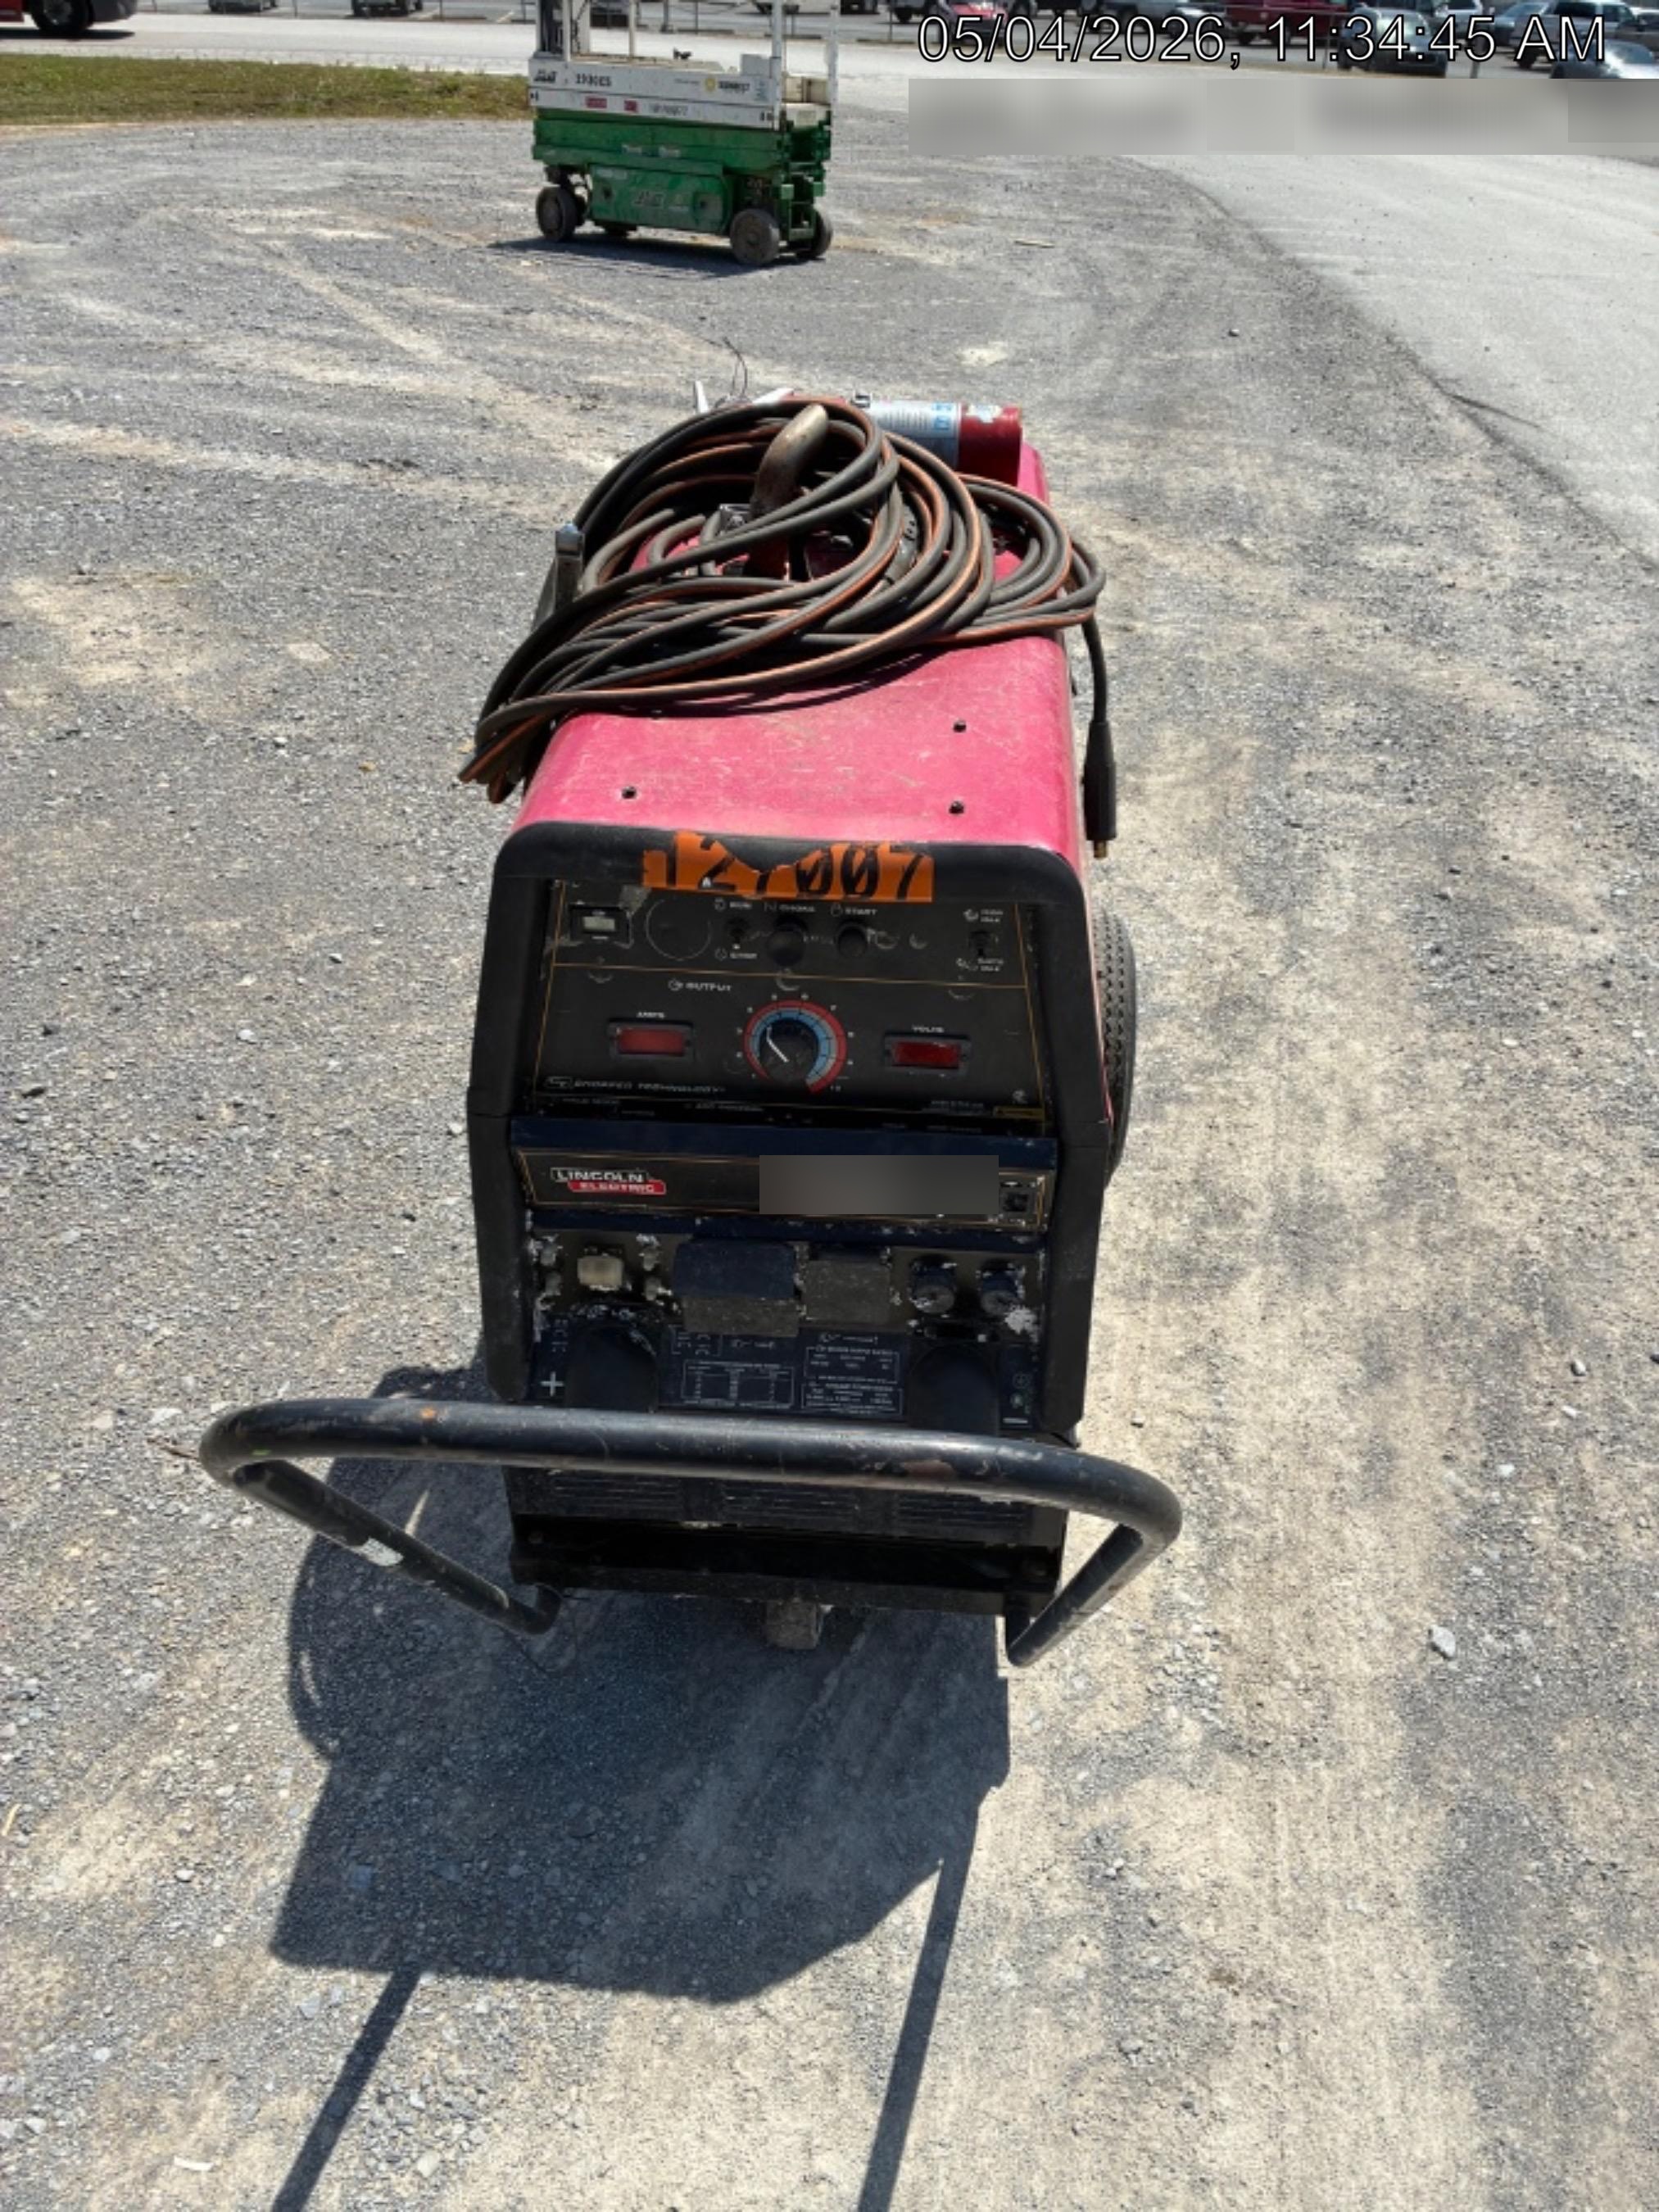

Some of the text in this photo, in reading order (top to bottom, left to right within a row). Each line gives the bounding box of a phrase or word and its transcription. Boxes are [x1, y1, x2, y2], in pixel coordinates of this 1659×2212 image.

[686, 982, 732, 991] OUTPUT
[557, 1168, 643, 1182] LINCOLN
[579, 1181, 655, 1193] ELECTRIC
